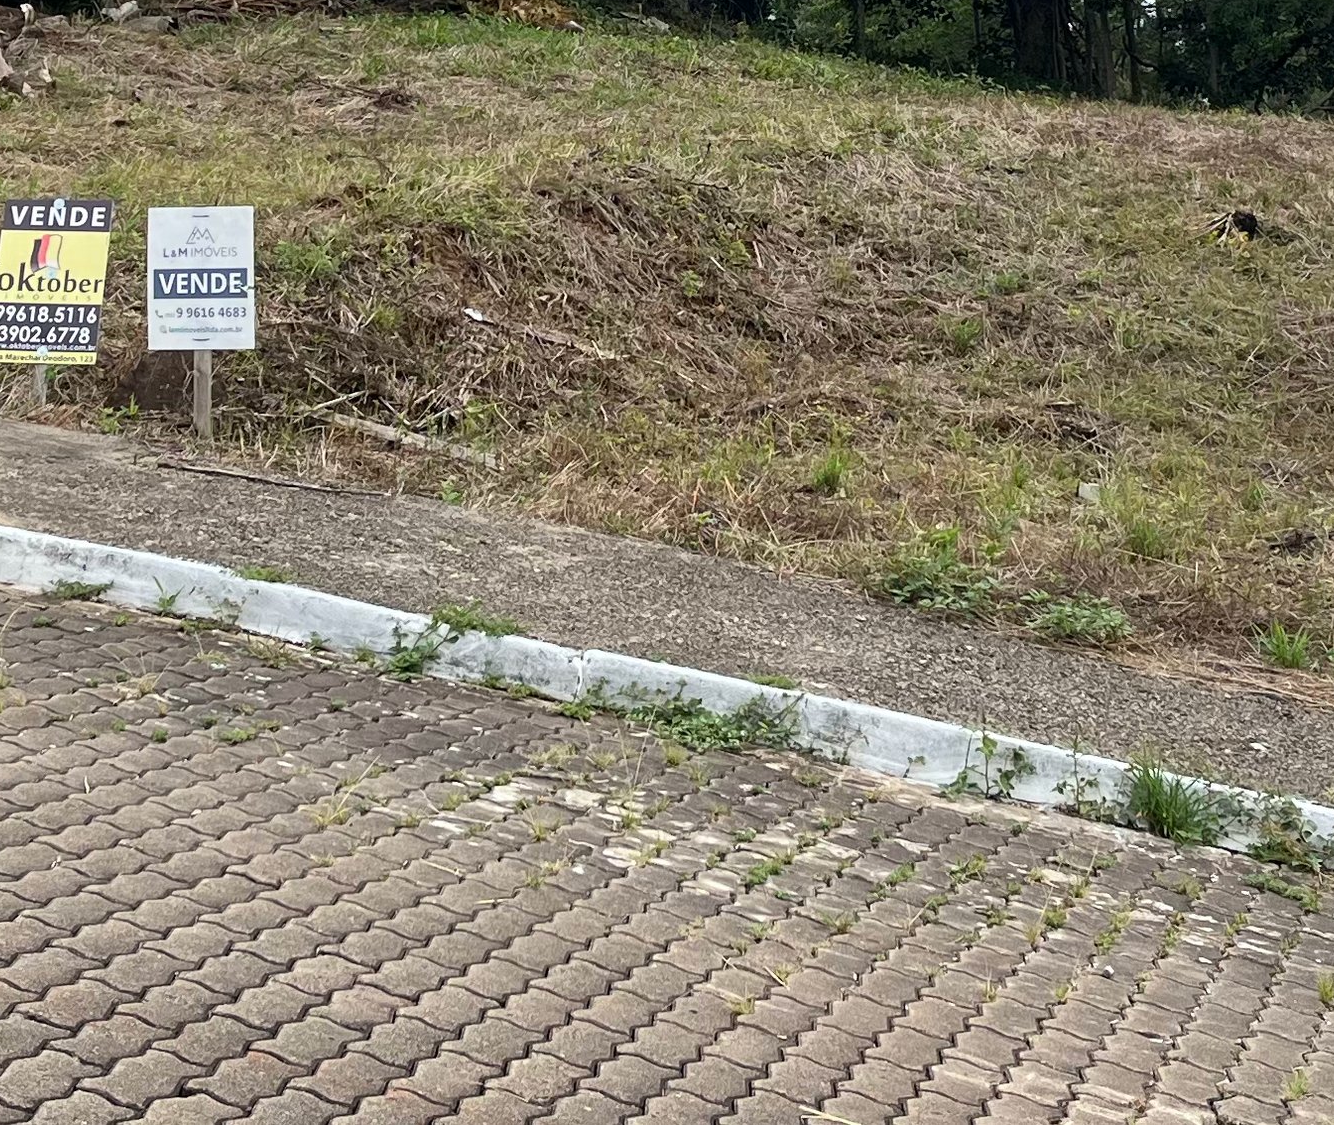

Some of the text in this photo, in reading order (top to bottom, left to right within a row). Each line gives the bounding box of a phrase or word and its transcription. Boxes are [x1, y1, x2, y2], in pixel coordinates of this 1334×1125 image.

[11, 205, 106, 227] VENDE
[190, 245, 238, 257] IMÓVEIS
[159, 273, 242, 294] VENDE
[186, 307, 215, 318] 9616
[218, 307, 247, 318] 4683
